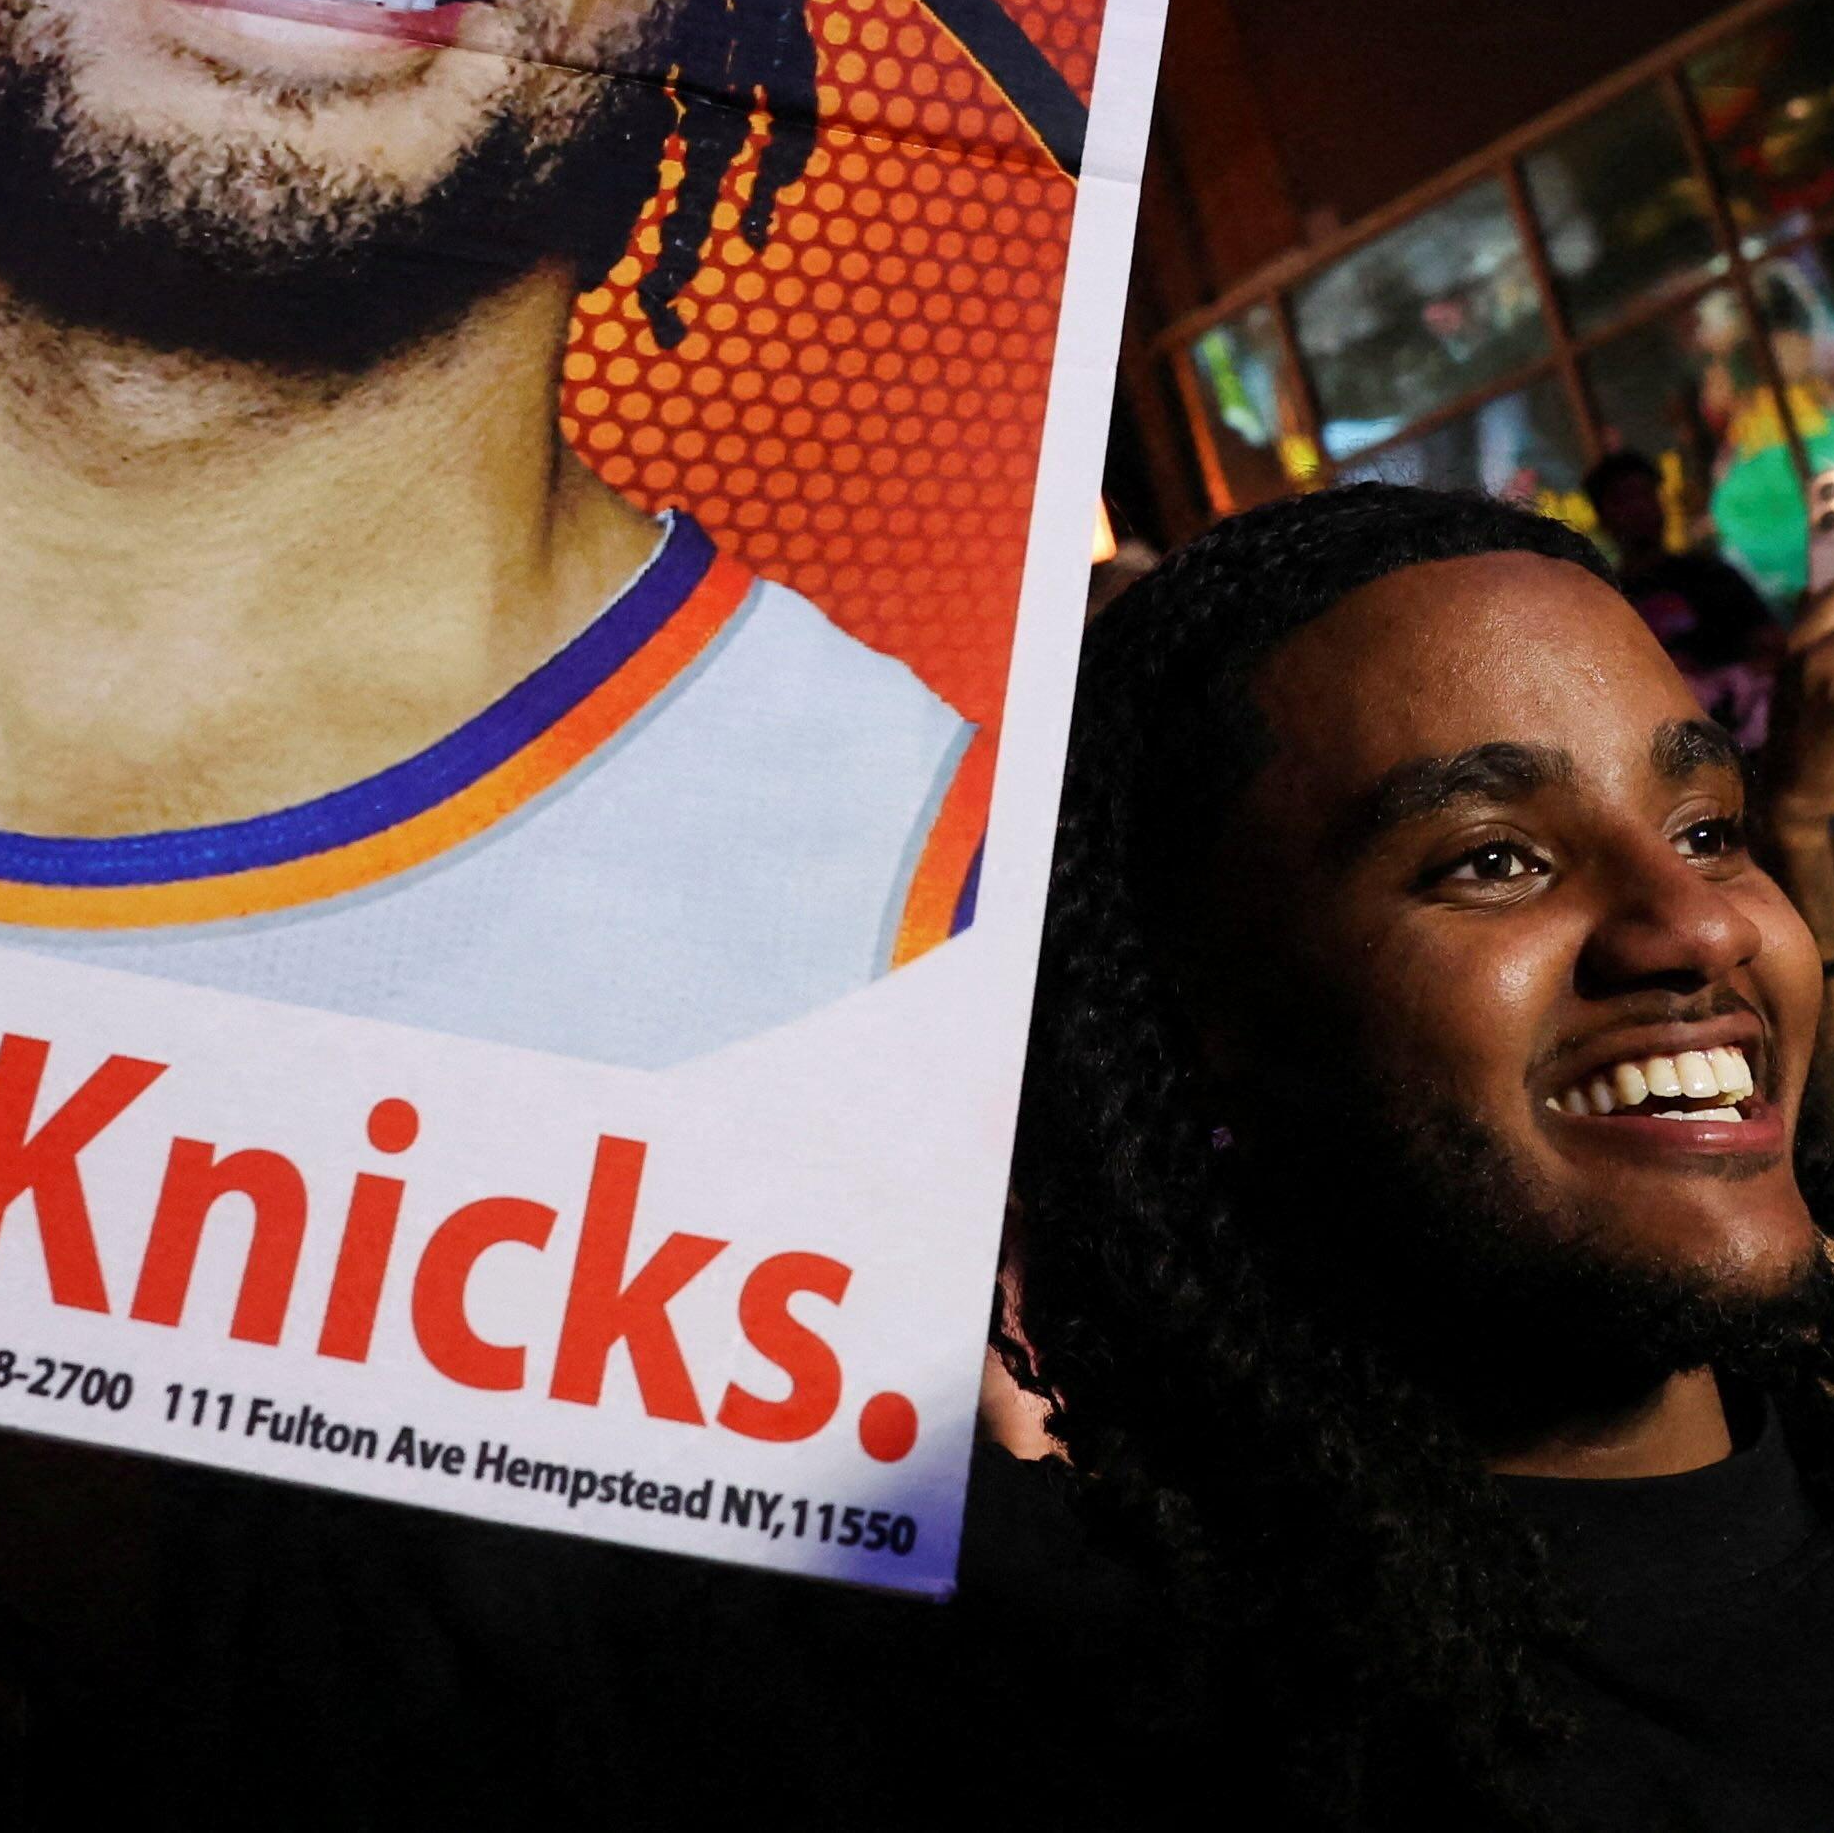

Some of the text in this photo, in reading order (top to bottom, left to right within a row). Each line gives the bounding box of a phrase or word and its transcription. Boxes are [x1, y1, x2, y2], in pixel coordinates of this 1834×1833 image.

[165, 1382, 235, 1432] 111
[244, 1397, 378, 1461] Fulton
[385, 1425, 466, 1475] Ave
[474, 1441, 715, 1521] Hempstead
[720, 1484, 917, 1557] NY,11550
